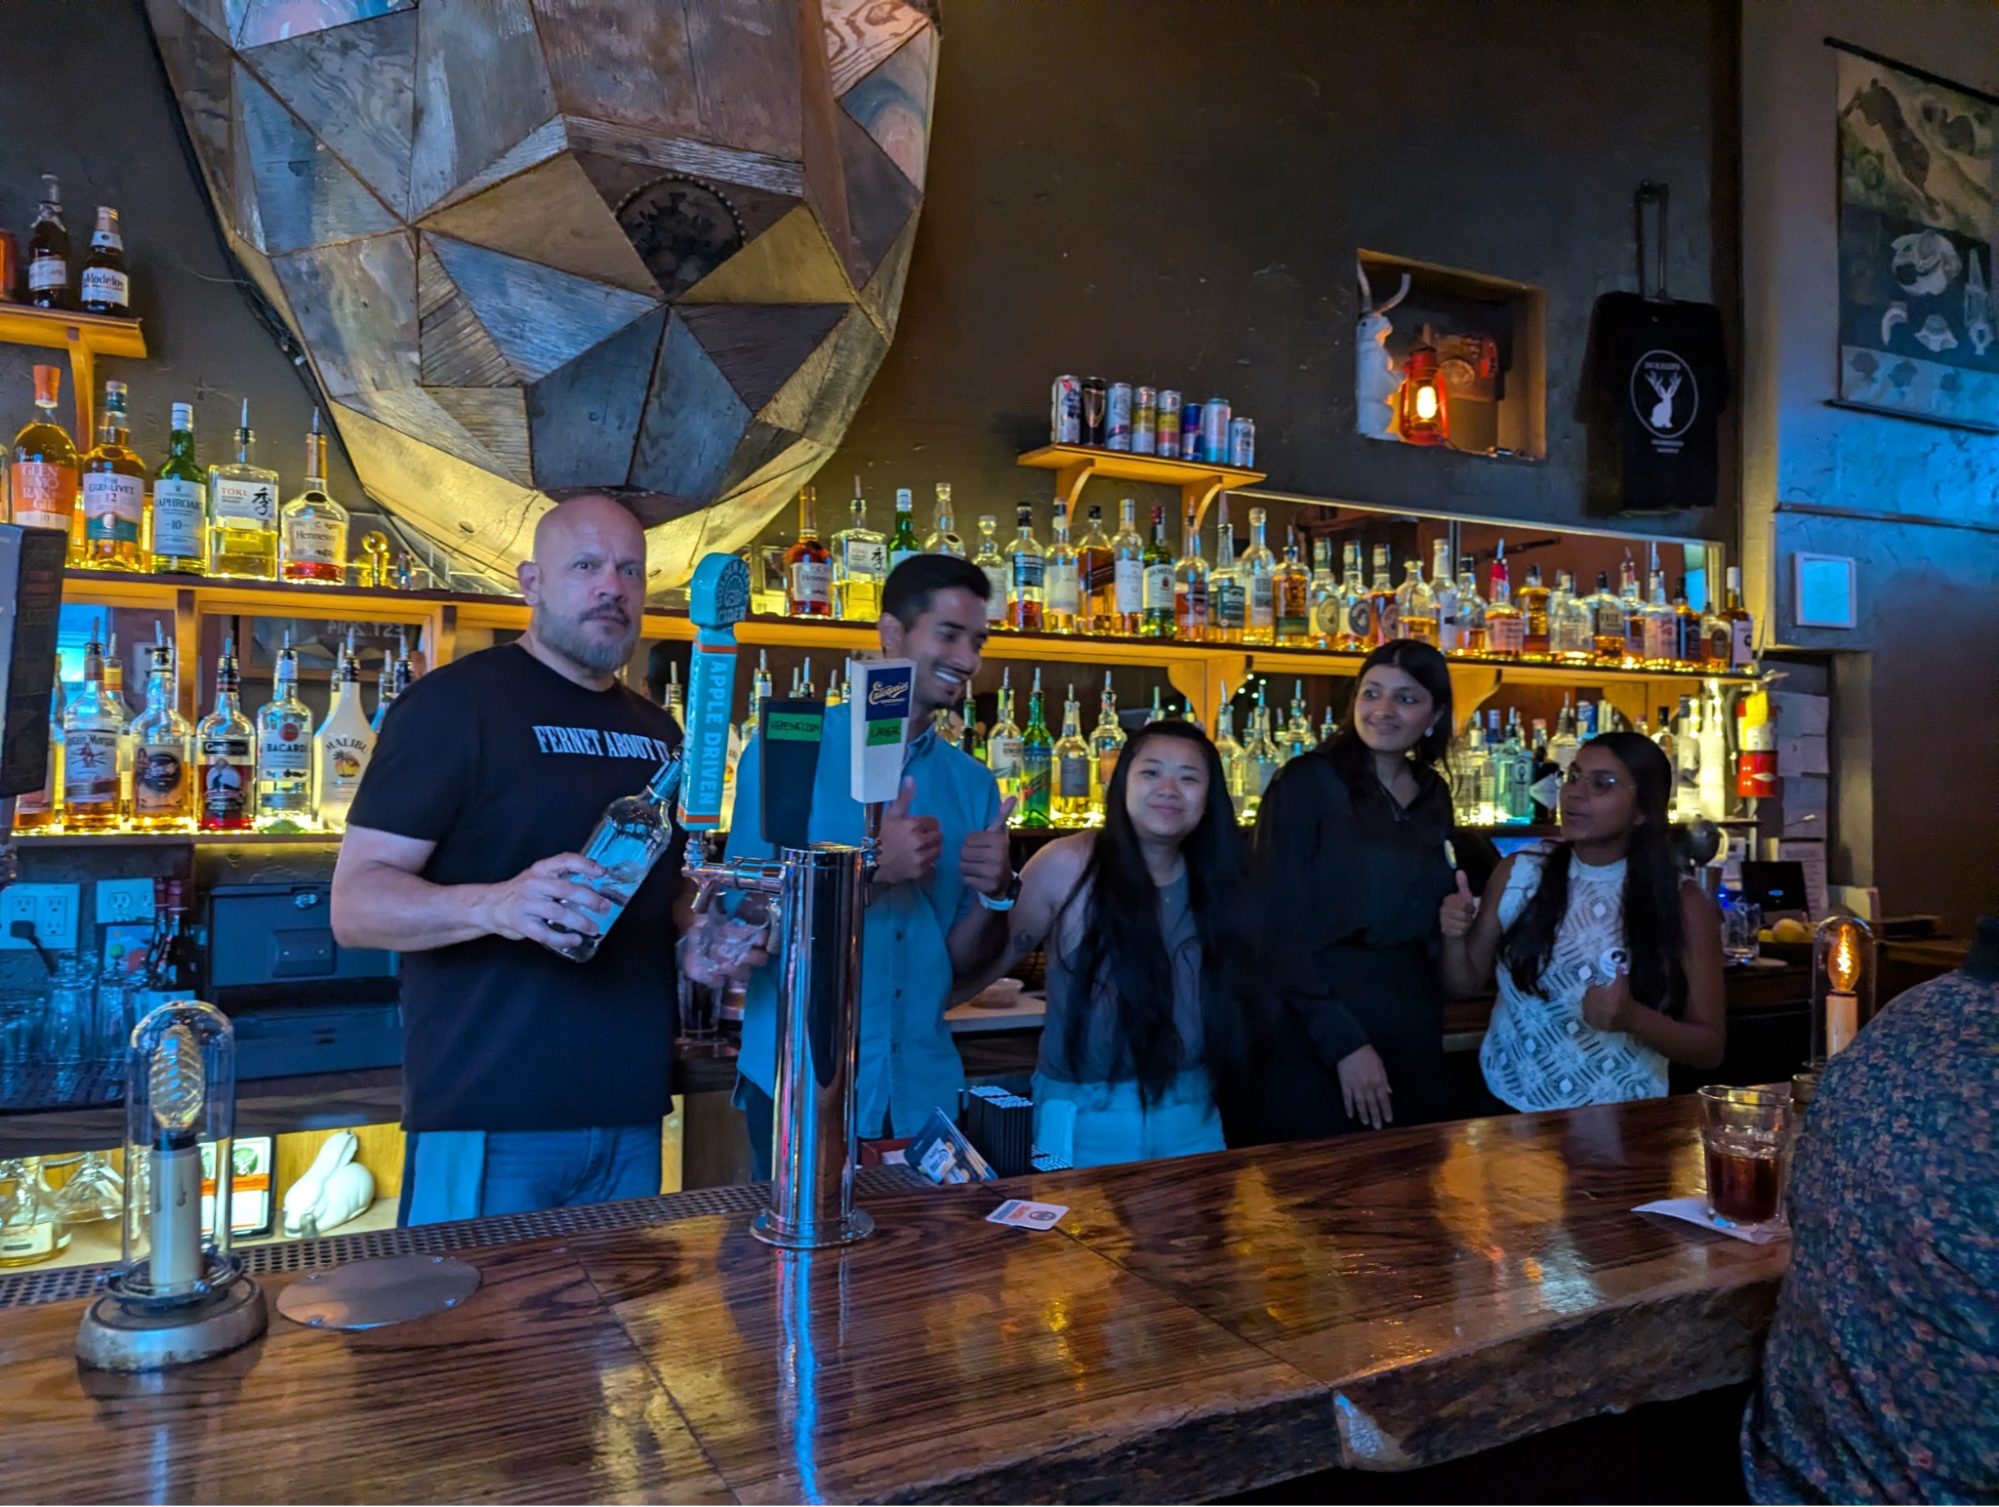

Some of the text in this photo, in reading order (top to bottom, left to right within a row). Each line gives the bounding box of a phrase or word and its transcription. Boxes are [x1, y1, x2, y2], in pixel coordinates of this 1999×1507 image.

[22, 465, 58, 477] GLEN
[88, 483, 135, 495] GLENLIVET
[221, 487, 248, 496] TOKI
[252, 487, 273, 516] 季
[171, 520, 182, 530] 10
[719, 606, 746, 625] CIDER
[698, 660, 728, 805] APPLE DRIVEN
[325, 738, 368, 754] MALIBU
[532, 725, 670, 763] FERNET ABOUT IT
